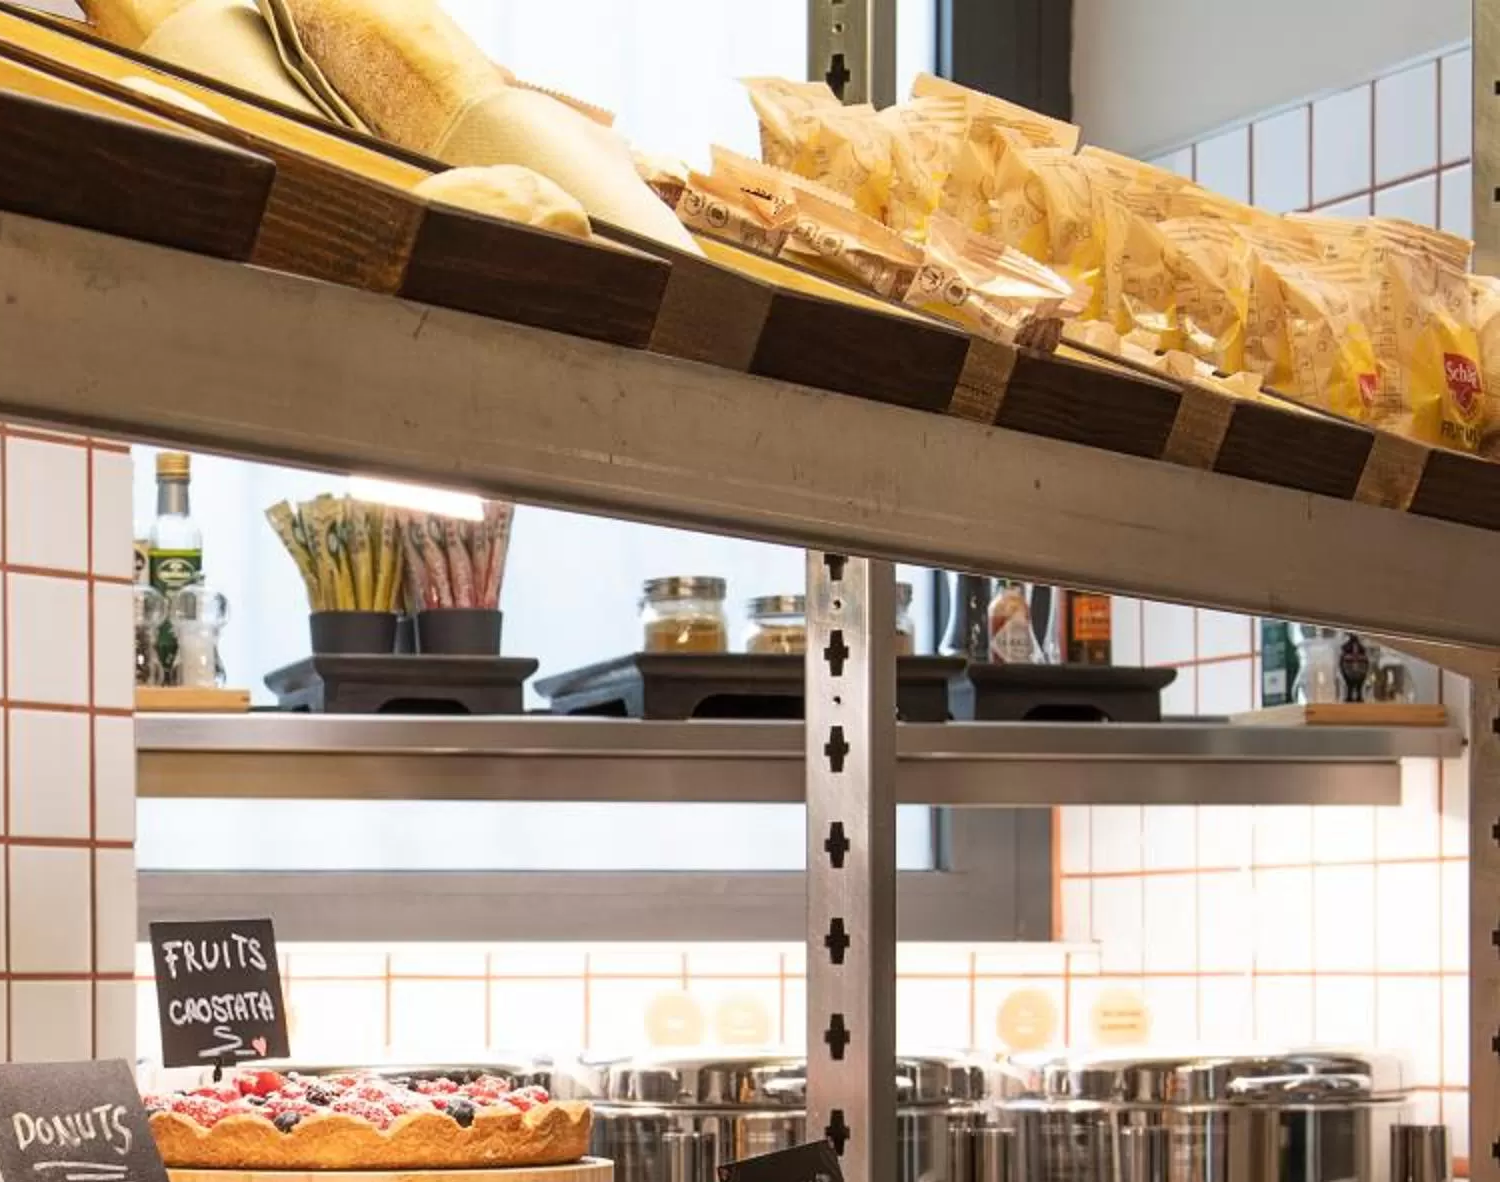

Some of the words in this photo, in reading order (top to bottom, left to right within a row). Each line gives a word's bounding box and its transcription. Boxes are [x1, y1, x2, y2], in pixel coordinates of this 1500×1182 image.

[161, 932, 268, 979] FRUITS
[168, 989, 275, 1026] CROSTATA
[11, 1102, 133, 1156] DONUTS
